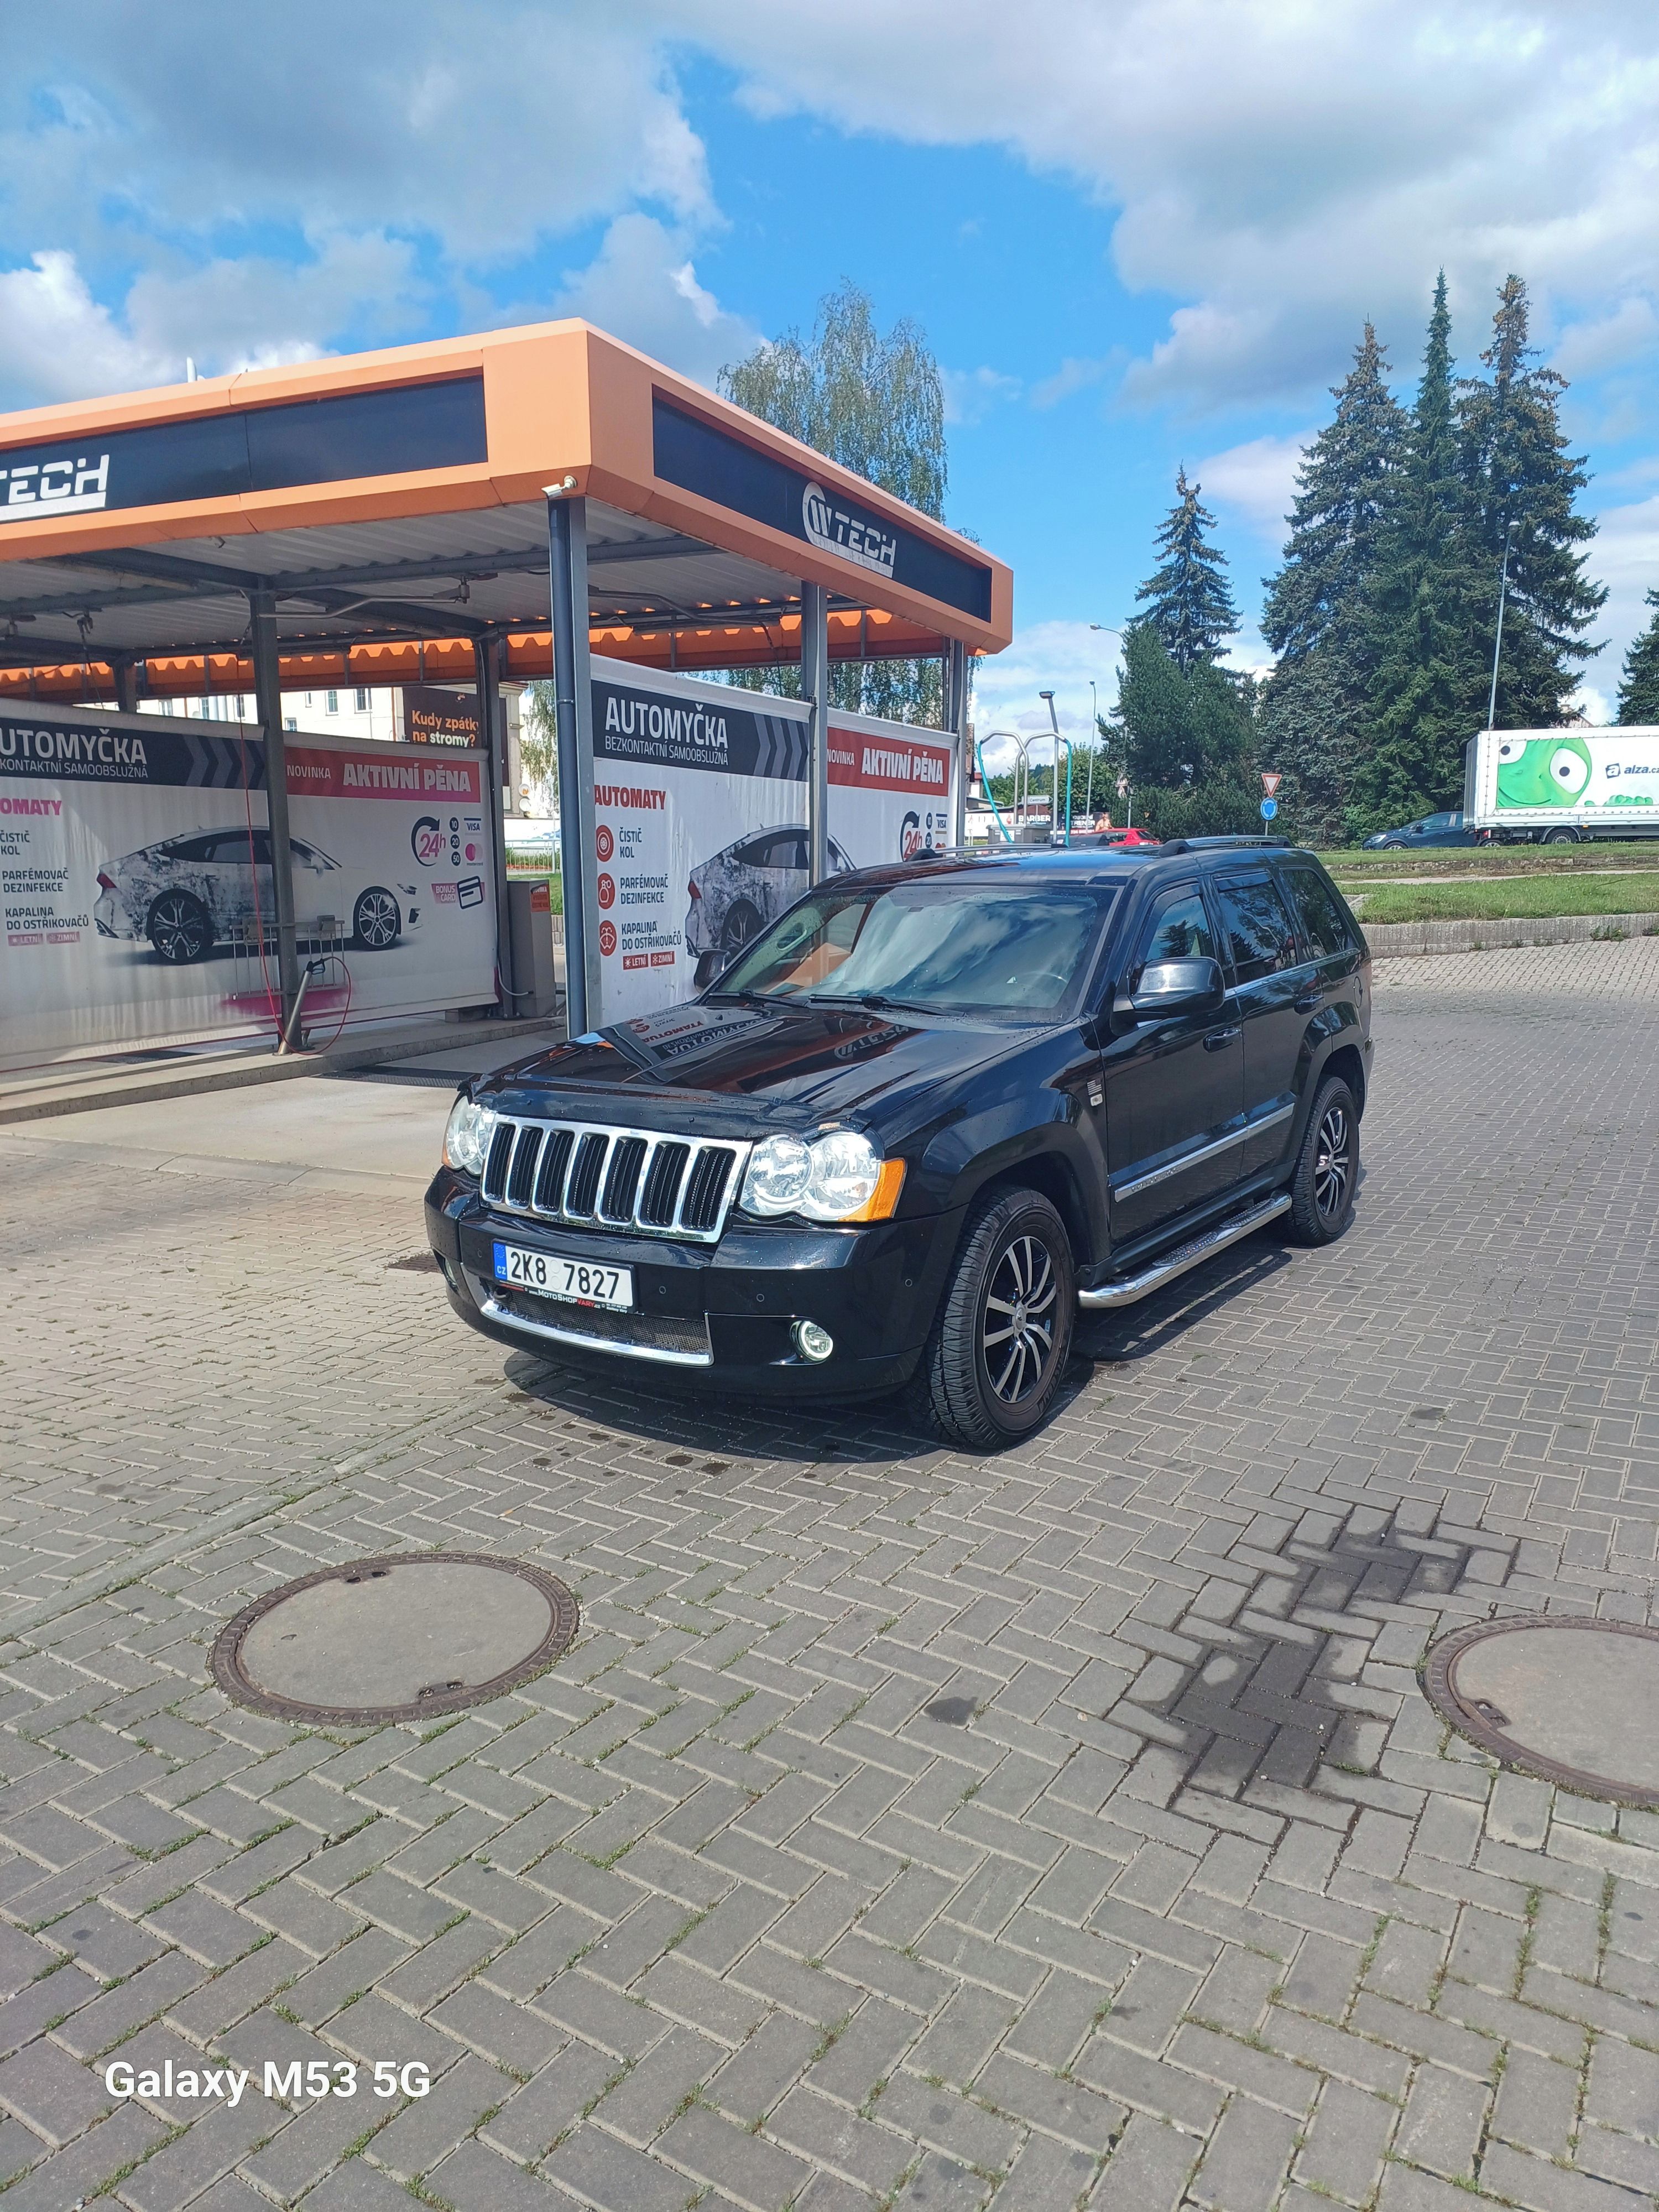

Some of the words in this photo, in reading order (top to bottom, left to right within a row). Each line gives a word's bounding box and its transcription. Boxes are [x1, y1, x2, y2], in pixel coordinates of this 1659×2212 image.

[0, 455, 109, 504] ECH
[412, 709, 442, 730] Kudy
[605, 697, 728, 749] AUTOMYČKA
[413, 731, 427, 742] na
[430, 731, 476, 748] stromy?
[605, 735, 667, 758] BEZKONTAKTNÍ
[669, 744, 728, 766] SAMOOBSLUŽNÁ
[65, 762, 148, 778] SAMOOBSLUŽNÁ
[827, 747, 855, 766] NOVINKA
[862, 747, 912, 780] AKTIVNÍ
[912, 751, 943, 784] PĚNA
[287, 765, 331, 779] NOVINKA
[343, 763, 420, 790] AKTIVNÍ
[424, 764, 471, 792] PĚNA
[594, 784, 666, 810] AUTOMATY
[451, 821, 457, 830] 10
[467, 822, 481, 831] VISA
[937, 819, 947, 828] VISA
[0, 830, 30, 843] ČISTIČ
[451, 837, 459, 846] 20
[619, 827, 642, 843] ČISTIČ
[1, 846, 20, 855] KOL
[419, 833, 446, 858] 24h
[620, 846, 635, 858] KOL
[452, 854, 460, 863] 50
[2, 867, 69, 880] PARFÉMOVAČ
[3, 883, 64, 893] DEZINFEKCE
[620, 874, 669, 889] PARFÉMOVAČ
[435, 885, 455, 894] BONUS
[440, 894, 456, 902] CARD
[620, 891, 665, 905] DEZINFEKCE
[5, 907, 54, 918] KAPALINA
[7, 920, 21, 930] DO
[23, 914, 89, 930] OSTŘIKOVAČŮ
[622, 921, 658, 935] KAPALINA
[20, 933, 39, 943] LETNÍ
[57, 933, 77, 942] ZIMNÍ
[622, 938, 633, 950] DO
[635, 930, 682, 949] OSTŘIKOVAČŮ
[632, 954, 646, 967] LETNÍ
[658, 951, 672, 963] ZIMNÍ
[497, 1265, 507, 1275] CZ
[510, 1251, 547, 1285] 2K8
[563, 1262, 619, 1300] 7827
